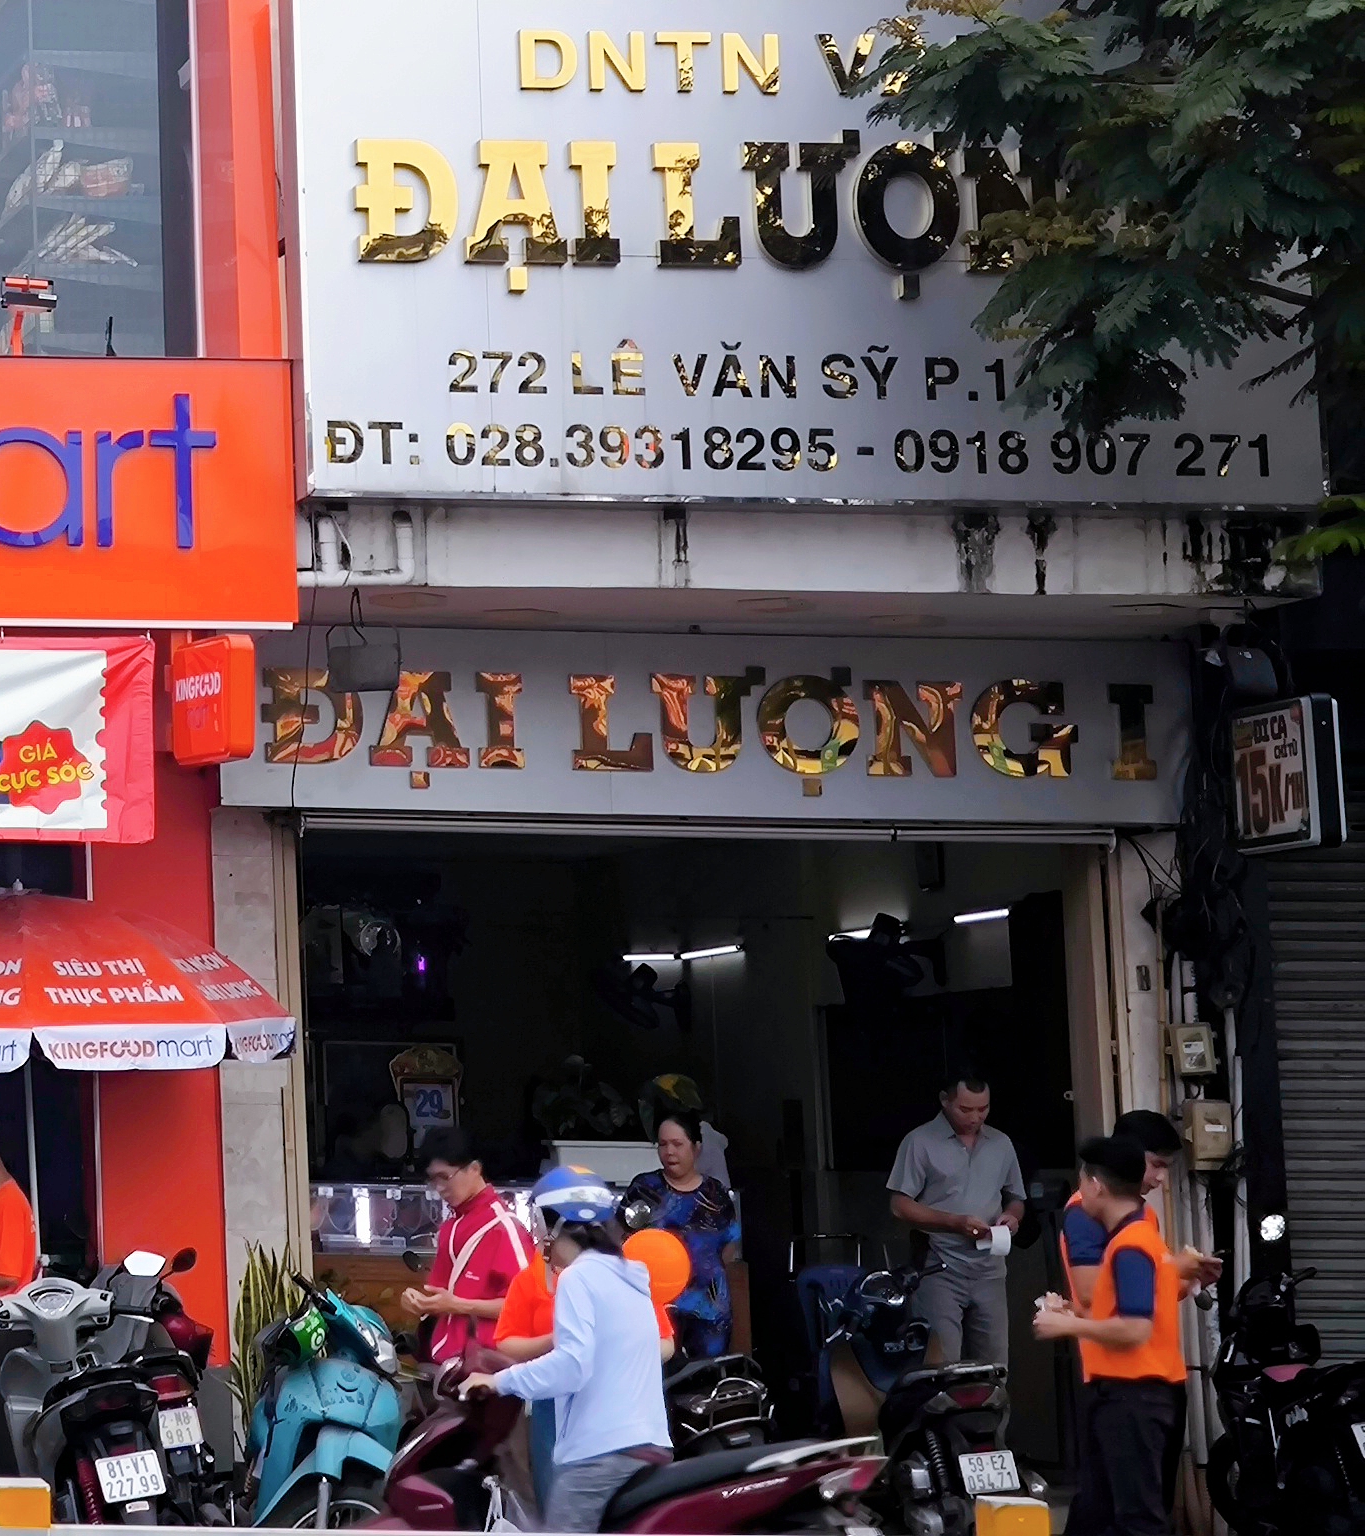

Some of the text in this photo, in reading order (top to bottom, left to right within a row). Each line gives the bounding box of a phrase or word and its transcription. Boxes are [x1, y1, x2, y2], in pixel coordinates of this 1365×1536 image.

[518, 28, 781, 96] DNTN
[353, 128, 1066, 302] ĐẠI LƯỢN
[447, 350, 549, 395] 272
[572, 337, 647, 396] LÊ
[671, 340, 799, 399] VĂN
[821, 342, 899, 400] SỸ
[325, 418, 1270, 478] ĐT: 028.39318295 0918 907 271
[175, 671, 222, 703] KINGFOOD
[262, 667, 526, 788] ĐẠI
[567, 666, 1079, 797] LƯỢNG
[18, 737, 58, 763] GIÁ
[47, 756, 95, 784] SỐC
[52, 955, 104, 977] SIÊU
[105, 957, 146, 978] THỊ
[44, 984, 109, 1008] THỰC
[110, 979, 185, 1004] PHẨM
[415, 1088, 445, 1119] 29
[106, 1456, 150, 1480] 81-V1
[105, 1474, 161, 1500] 227.99
